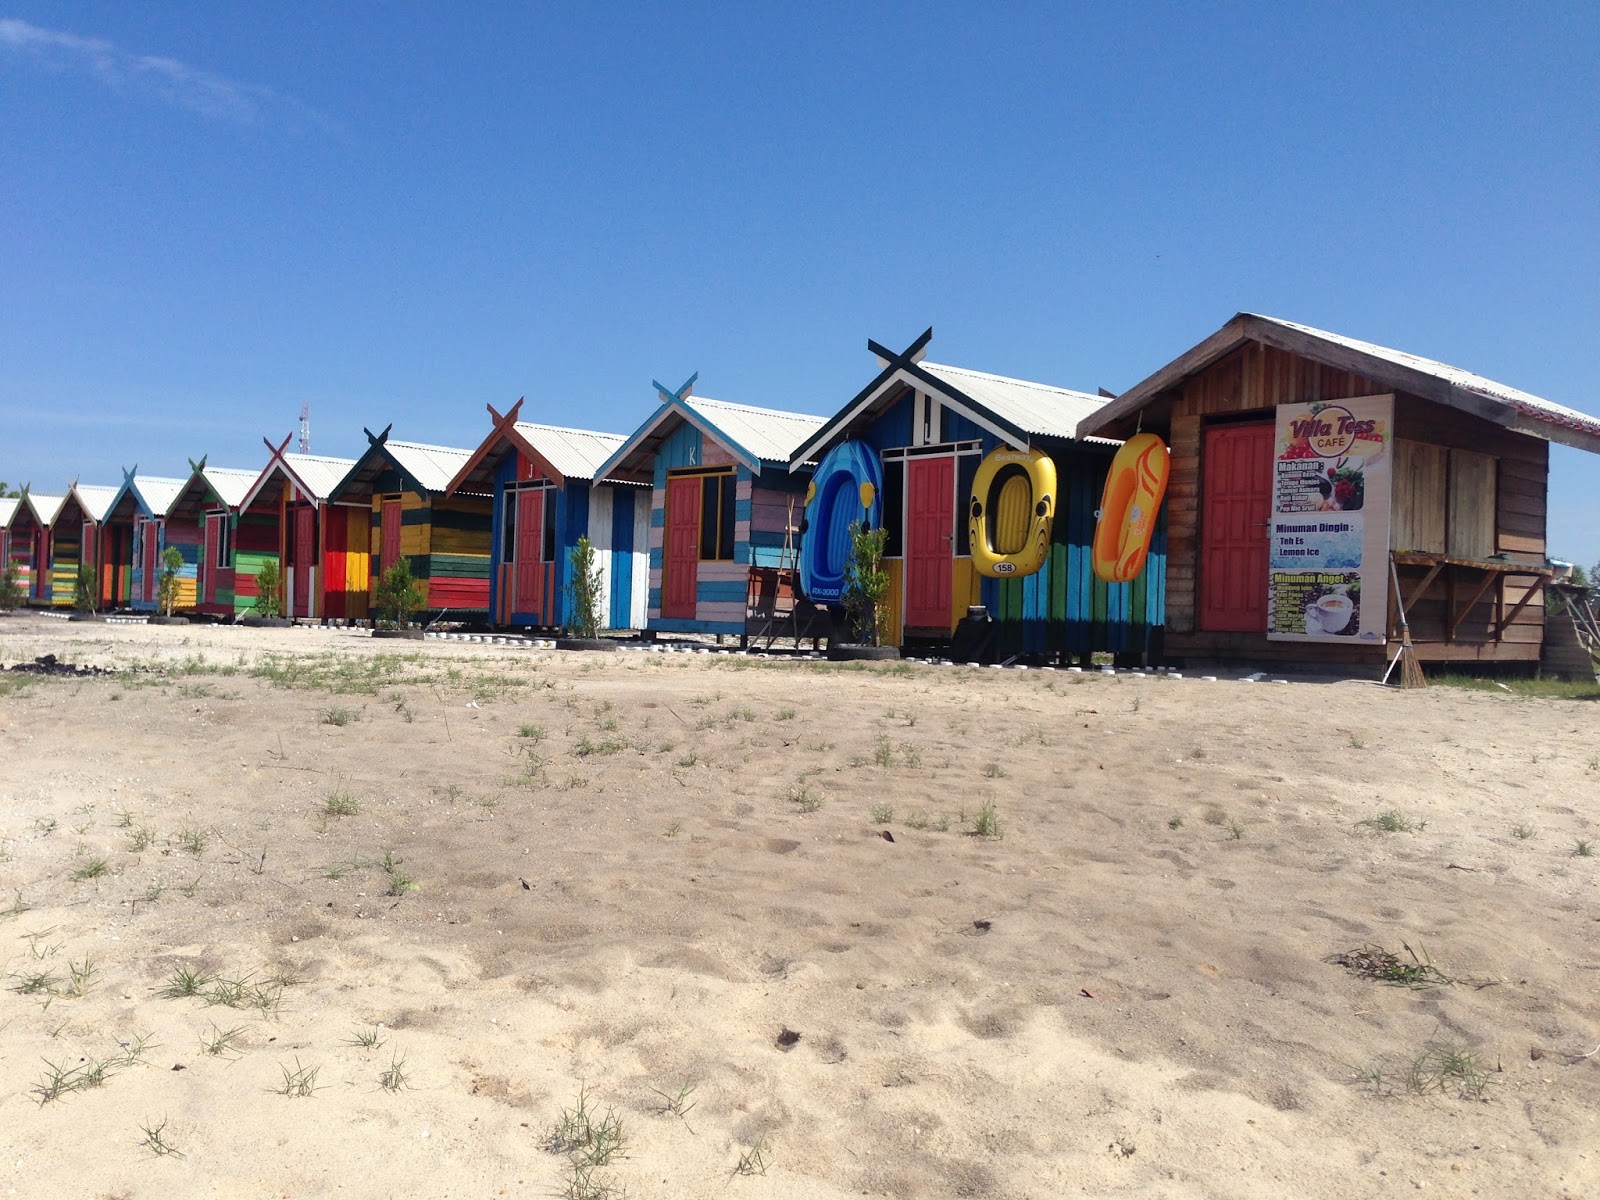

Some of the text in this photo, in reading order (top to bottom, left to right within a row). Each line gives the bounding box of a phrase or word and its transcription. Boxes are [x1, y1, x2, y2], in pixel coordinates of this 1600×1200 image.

[1289, 415, 1377, 439] Villa Tess
[1317, 437, 1345, 448] CAFÉ
[689, 446, 696, 466] K
[528, 463, 533, 479] J
[1278, 461, 1319, 472] Makanan
[1276, 524, 1317, 533] Minuman
[1319, 522, 1349, 533] Dingin
[1280, 537, 1304, 545] Teh Es
[1279, 548, 1320, 556] Lemon Ice
[998, 564, 1013, 572] 158
[1274, 574, 1316, 584] Minuman
[1316, 574, 1345, 584] Anget
[811, 587, 839, 596] RX-3000
